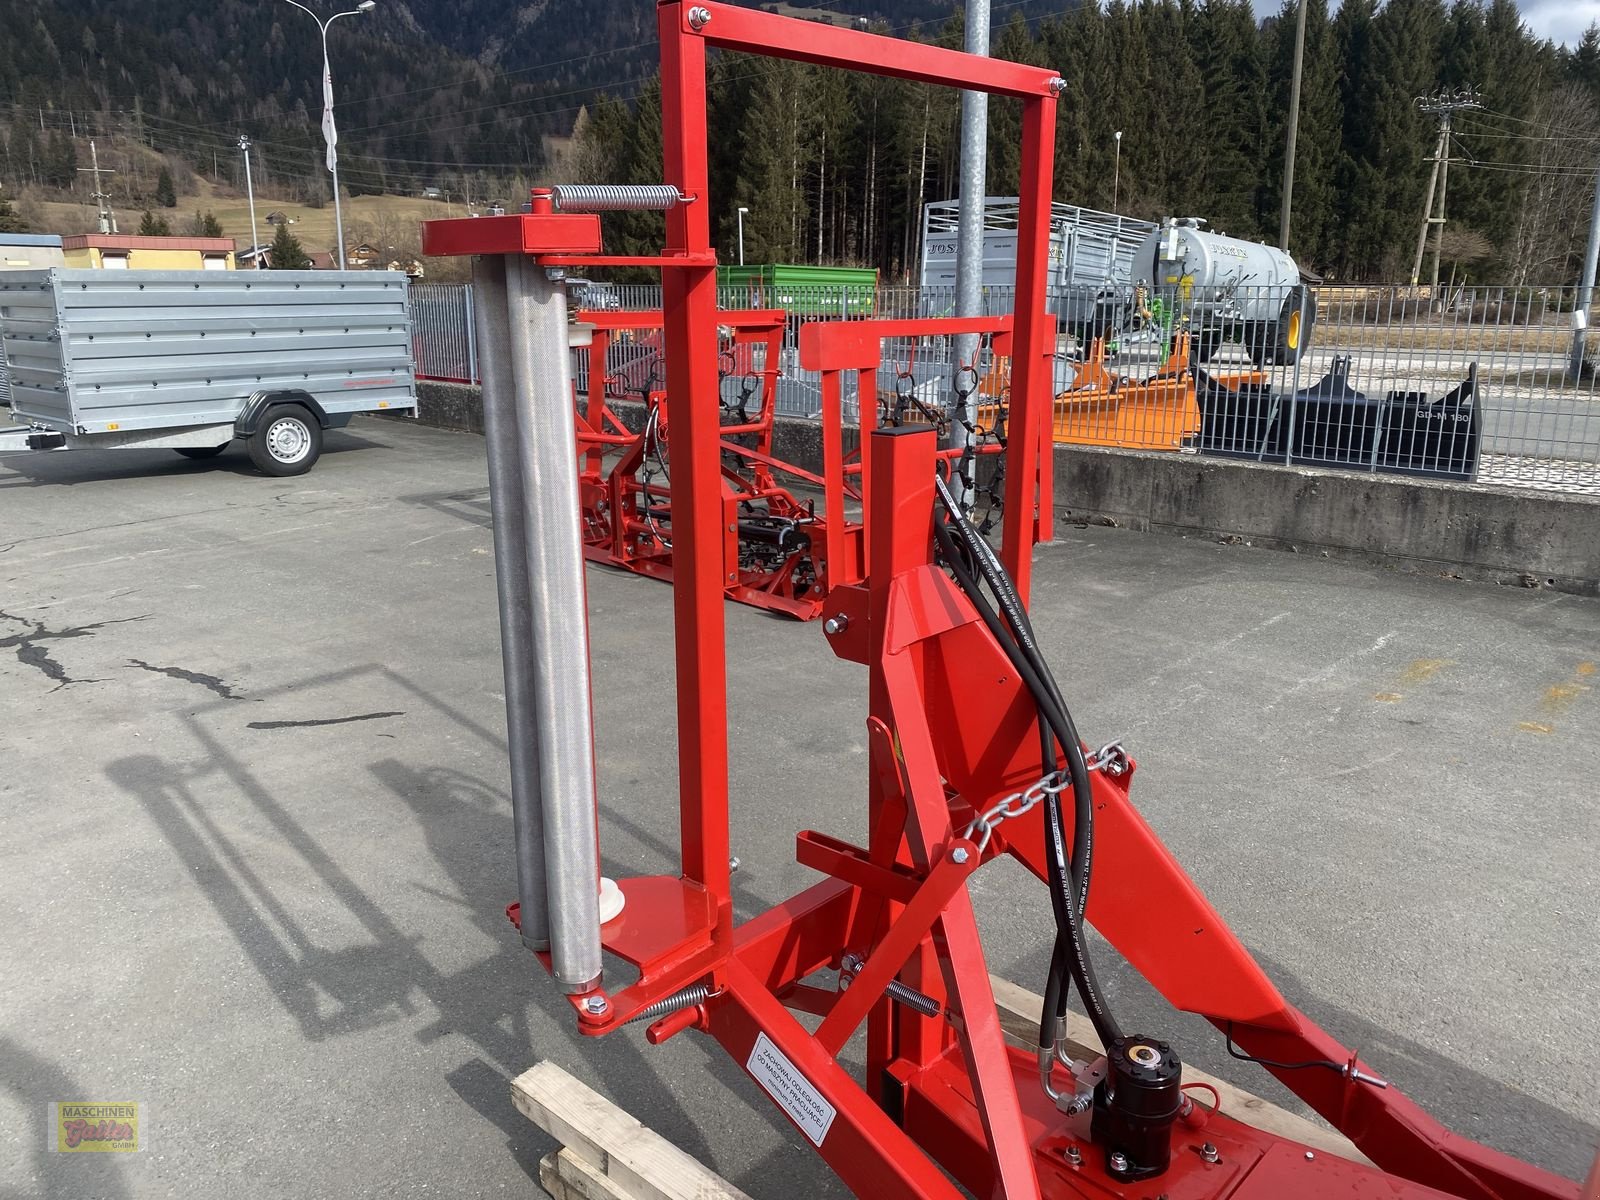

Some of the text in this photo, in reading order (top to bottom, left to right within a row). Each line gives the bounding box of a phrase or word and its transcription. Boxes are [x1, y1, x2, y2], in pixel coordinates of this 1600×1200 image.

[1062, 879, 1068, 887] EN
[757, 1054, 824, 1128] OD MASZYNY PRACUJĄCEJ
[763, 1049, 825, 1116] ZACHOWAJ ODLEGŁOŚĆ
[767, 1079, 805, 1121] minimum 2 metry
